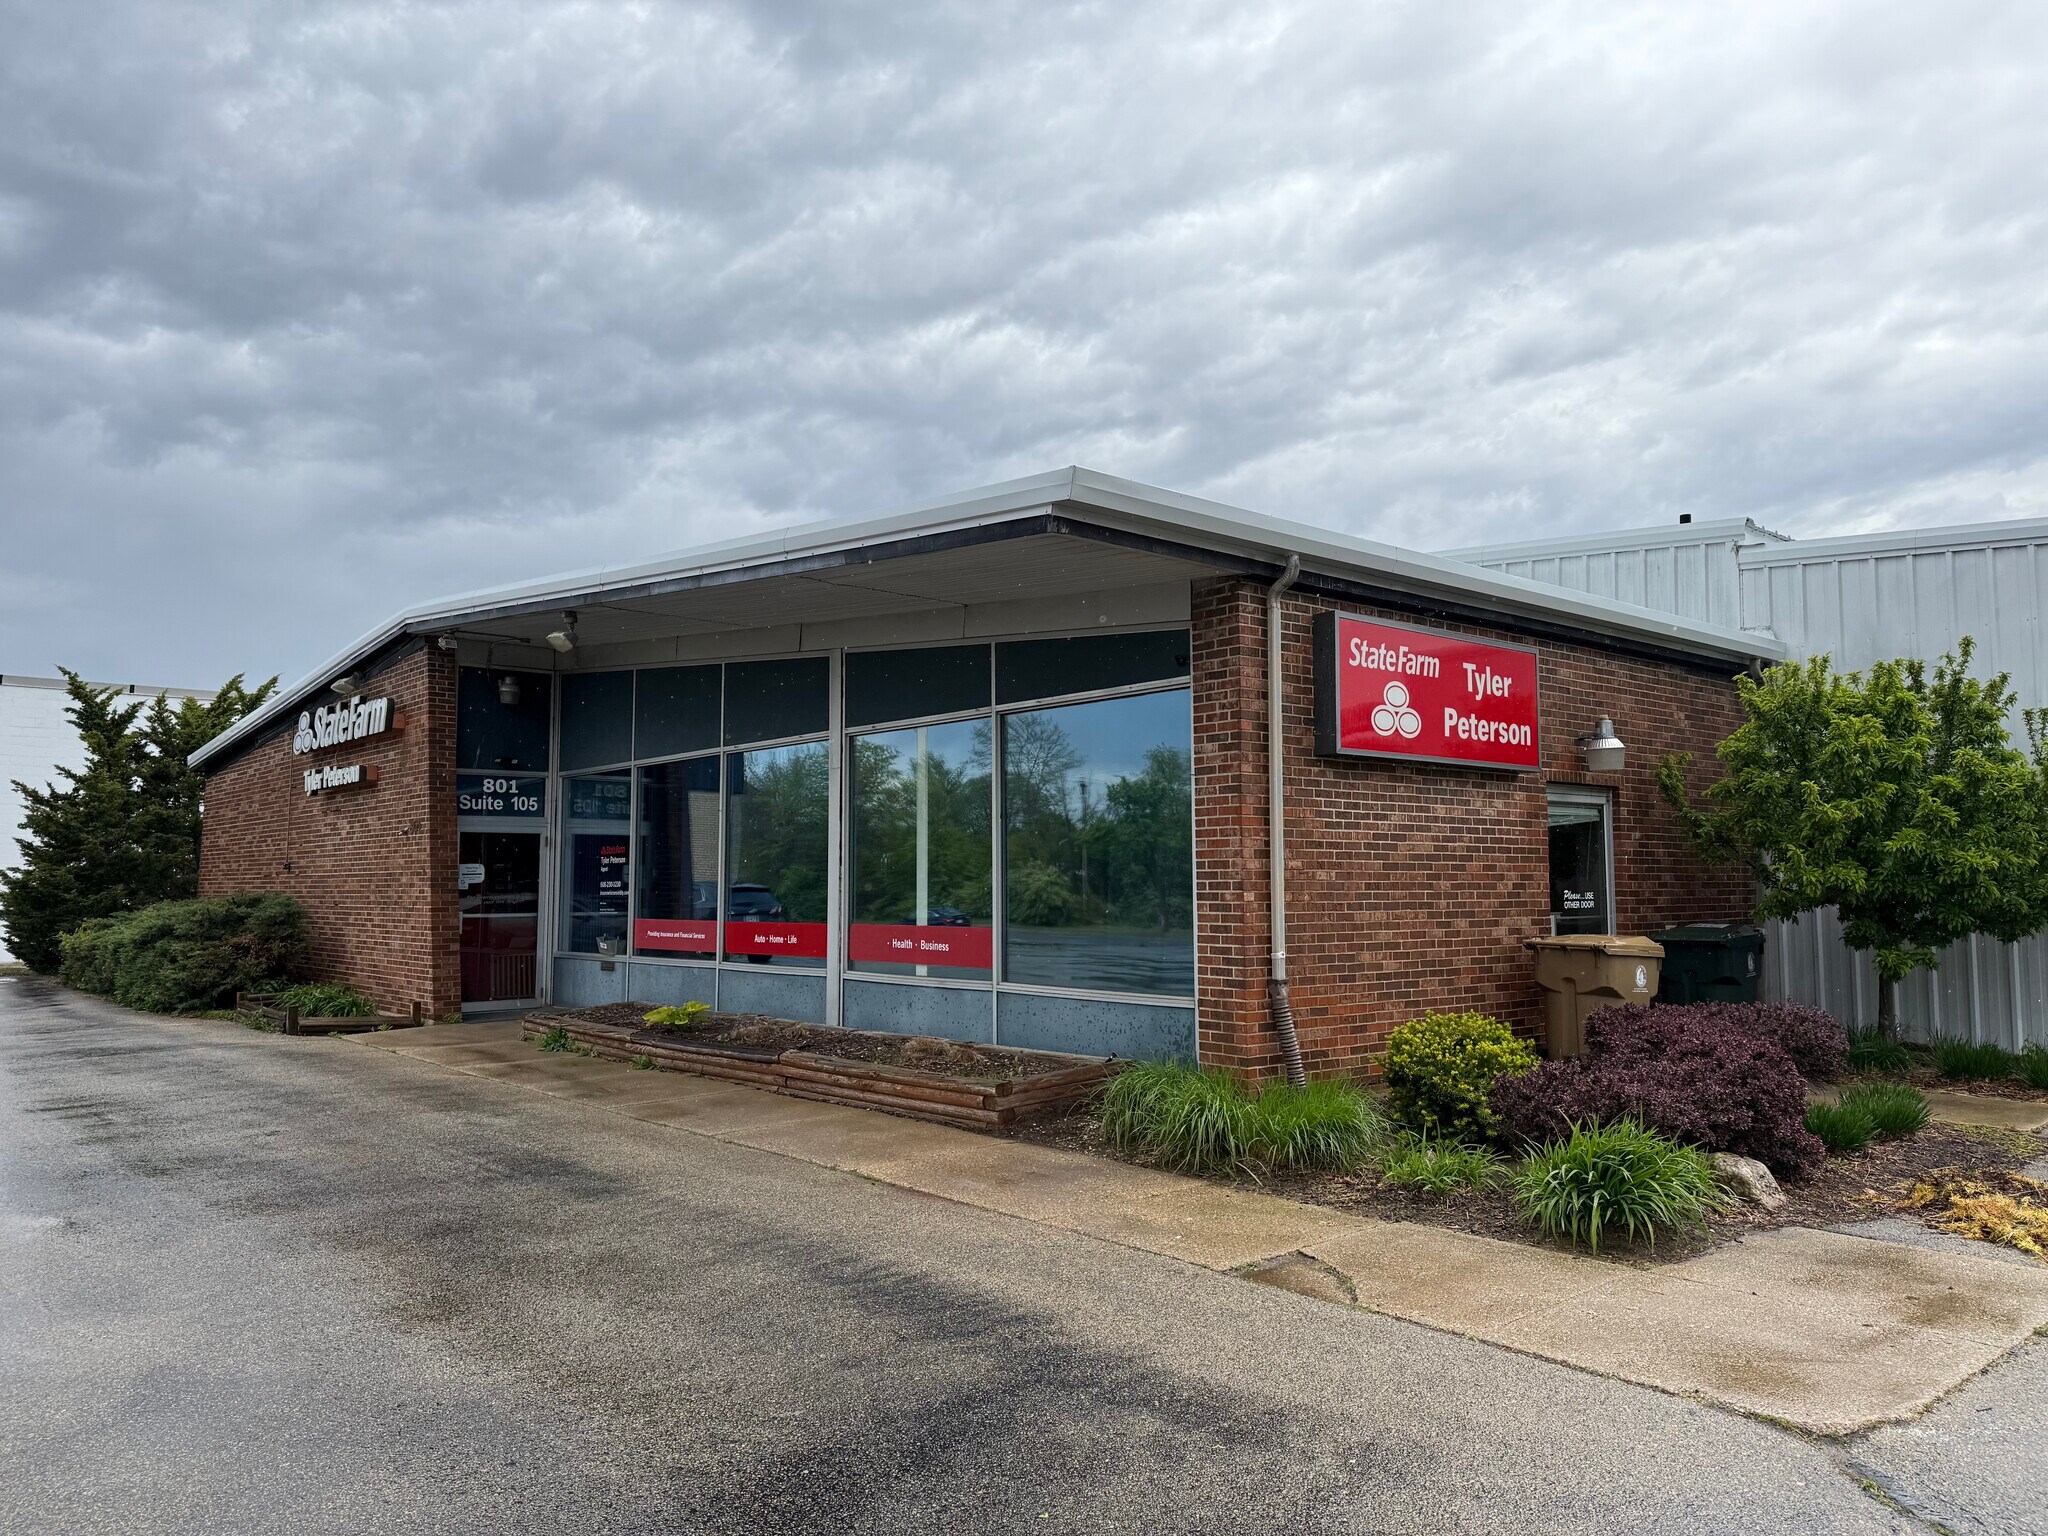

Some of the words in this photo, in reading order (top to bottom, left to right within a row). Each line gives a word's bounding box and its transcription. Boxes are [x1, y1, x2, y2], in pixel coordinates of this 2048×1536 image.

[1463, 662, 1512, 701] Tyler
[1444, 707, 1531, 746] Peterson
[303, 768, 323, 797] Tyler
[323, 764, 360, 789] Peterson
[482, 778, 518, 794] 801
[459, 795, 504, 811] Suite
[511, 796, 538, 811] 105
[1564, 901, 1580, 909] OTHER
[754, 934, 766, 943] Auto
[769, 934, 784, 944] Home
[787, 934, 798, 944] Life
[892, 938, 913, 949] Health
[920, 939, 950, 951] Business
